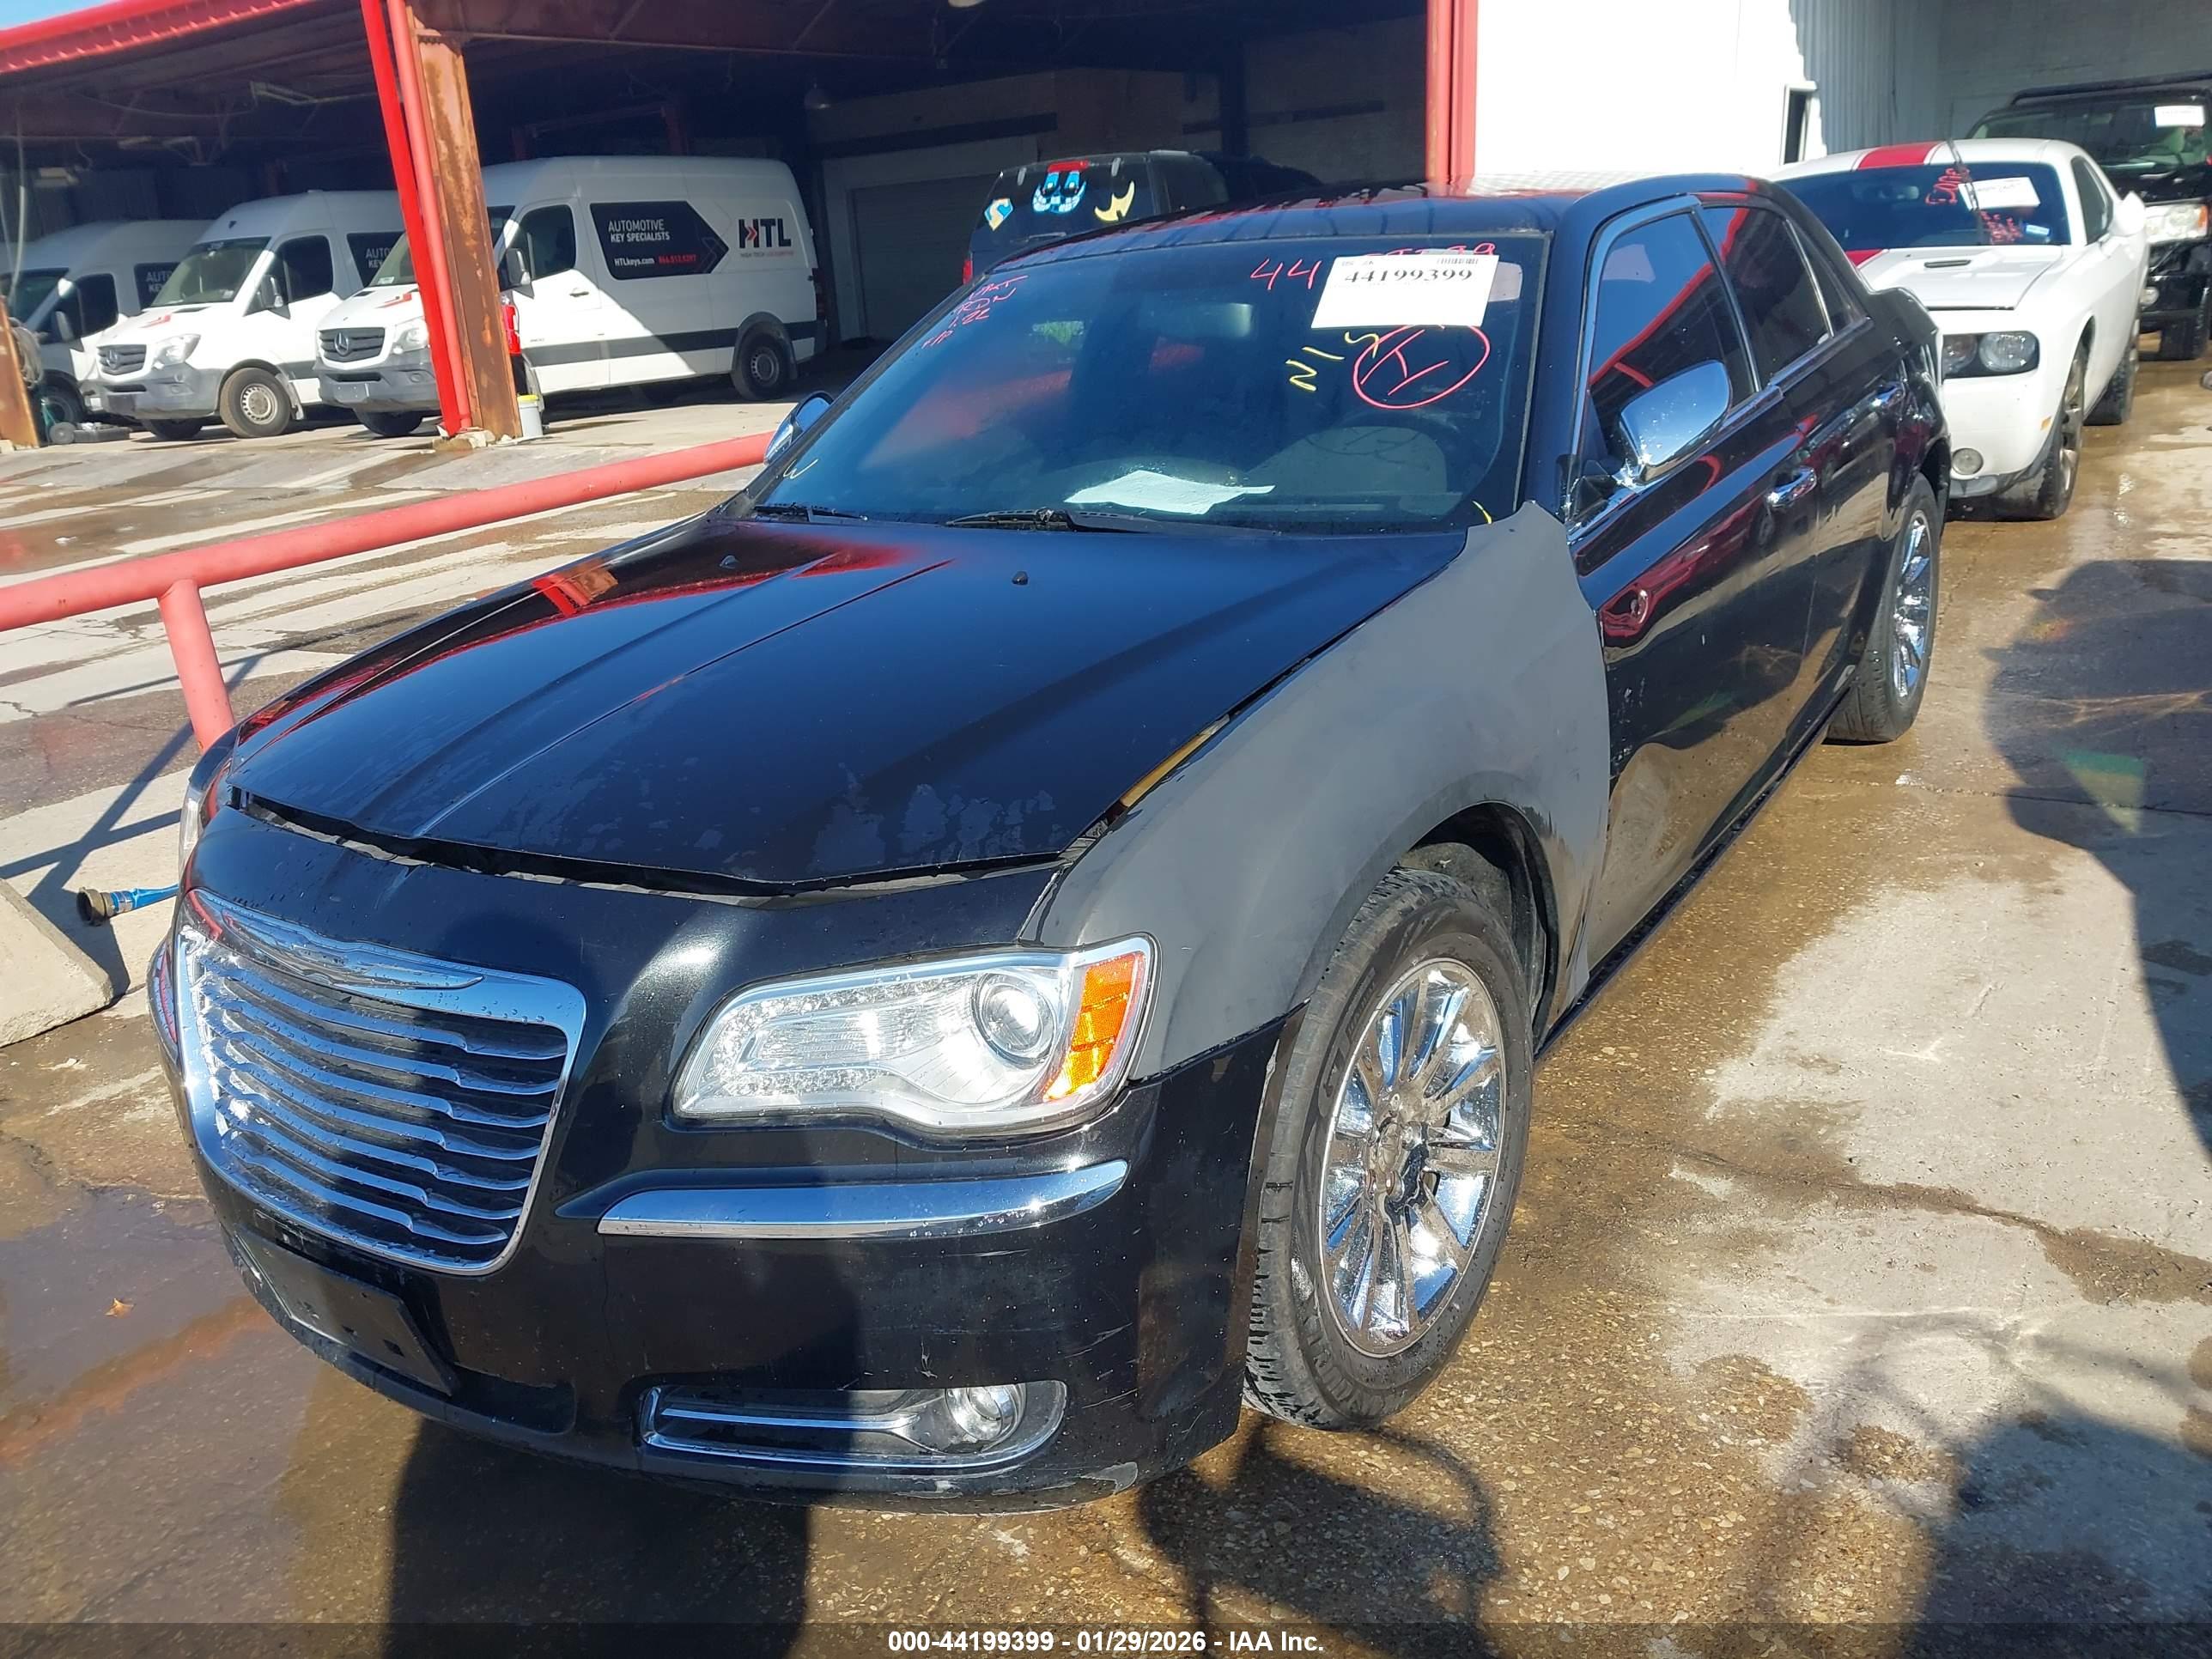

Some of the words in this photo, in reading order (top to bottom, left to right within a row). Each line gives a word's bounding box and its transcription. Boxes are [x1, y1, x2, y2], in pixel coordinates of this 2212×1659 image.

[608, 219, 665, 232] AUTOMOTIVE
[611, 233, 625, 243] KEY
[627, 231, 671, 242] SPECIALISTS
[738, 218, 792, 249] HTL
[1344, 268, 1474, 283] 44199399
